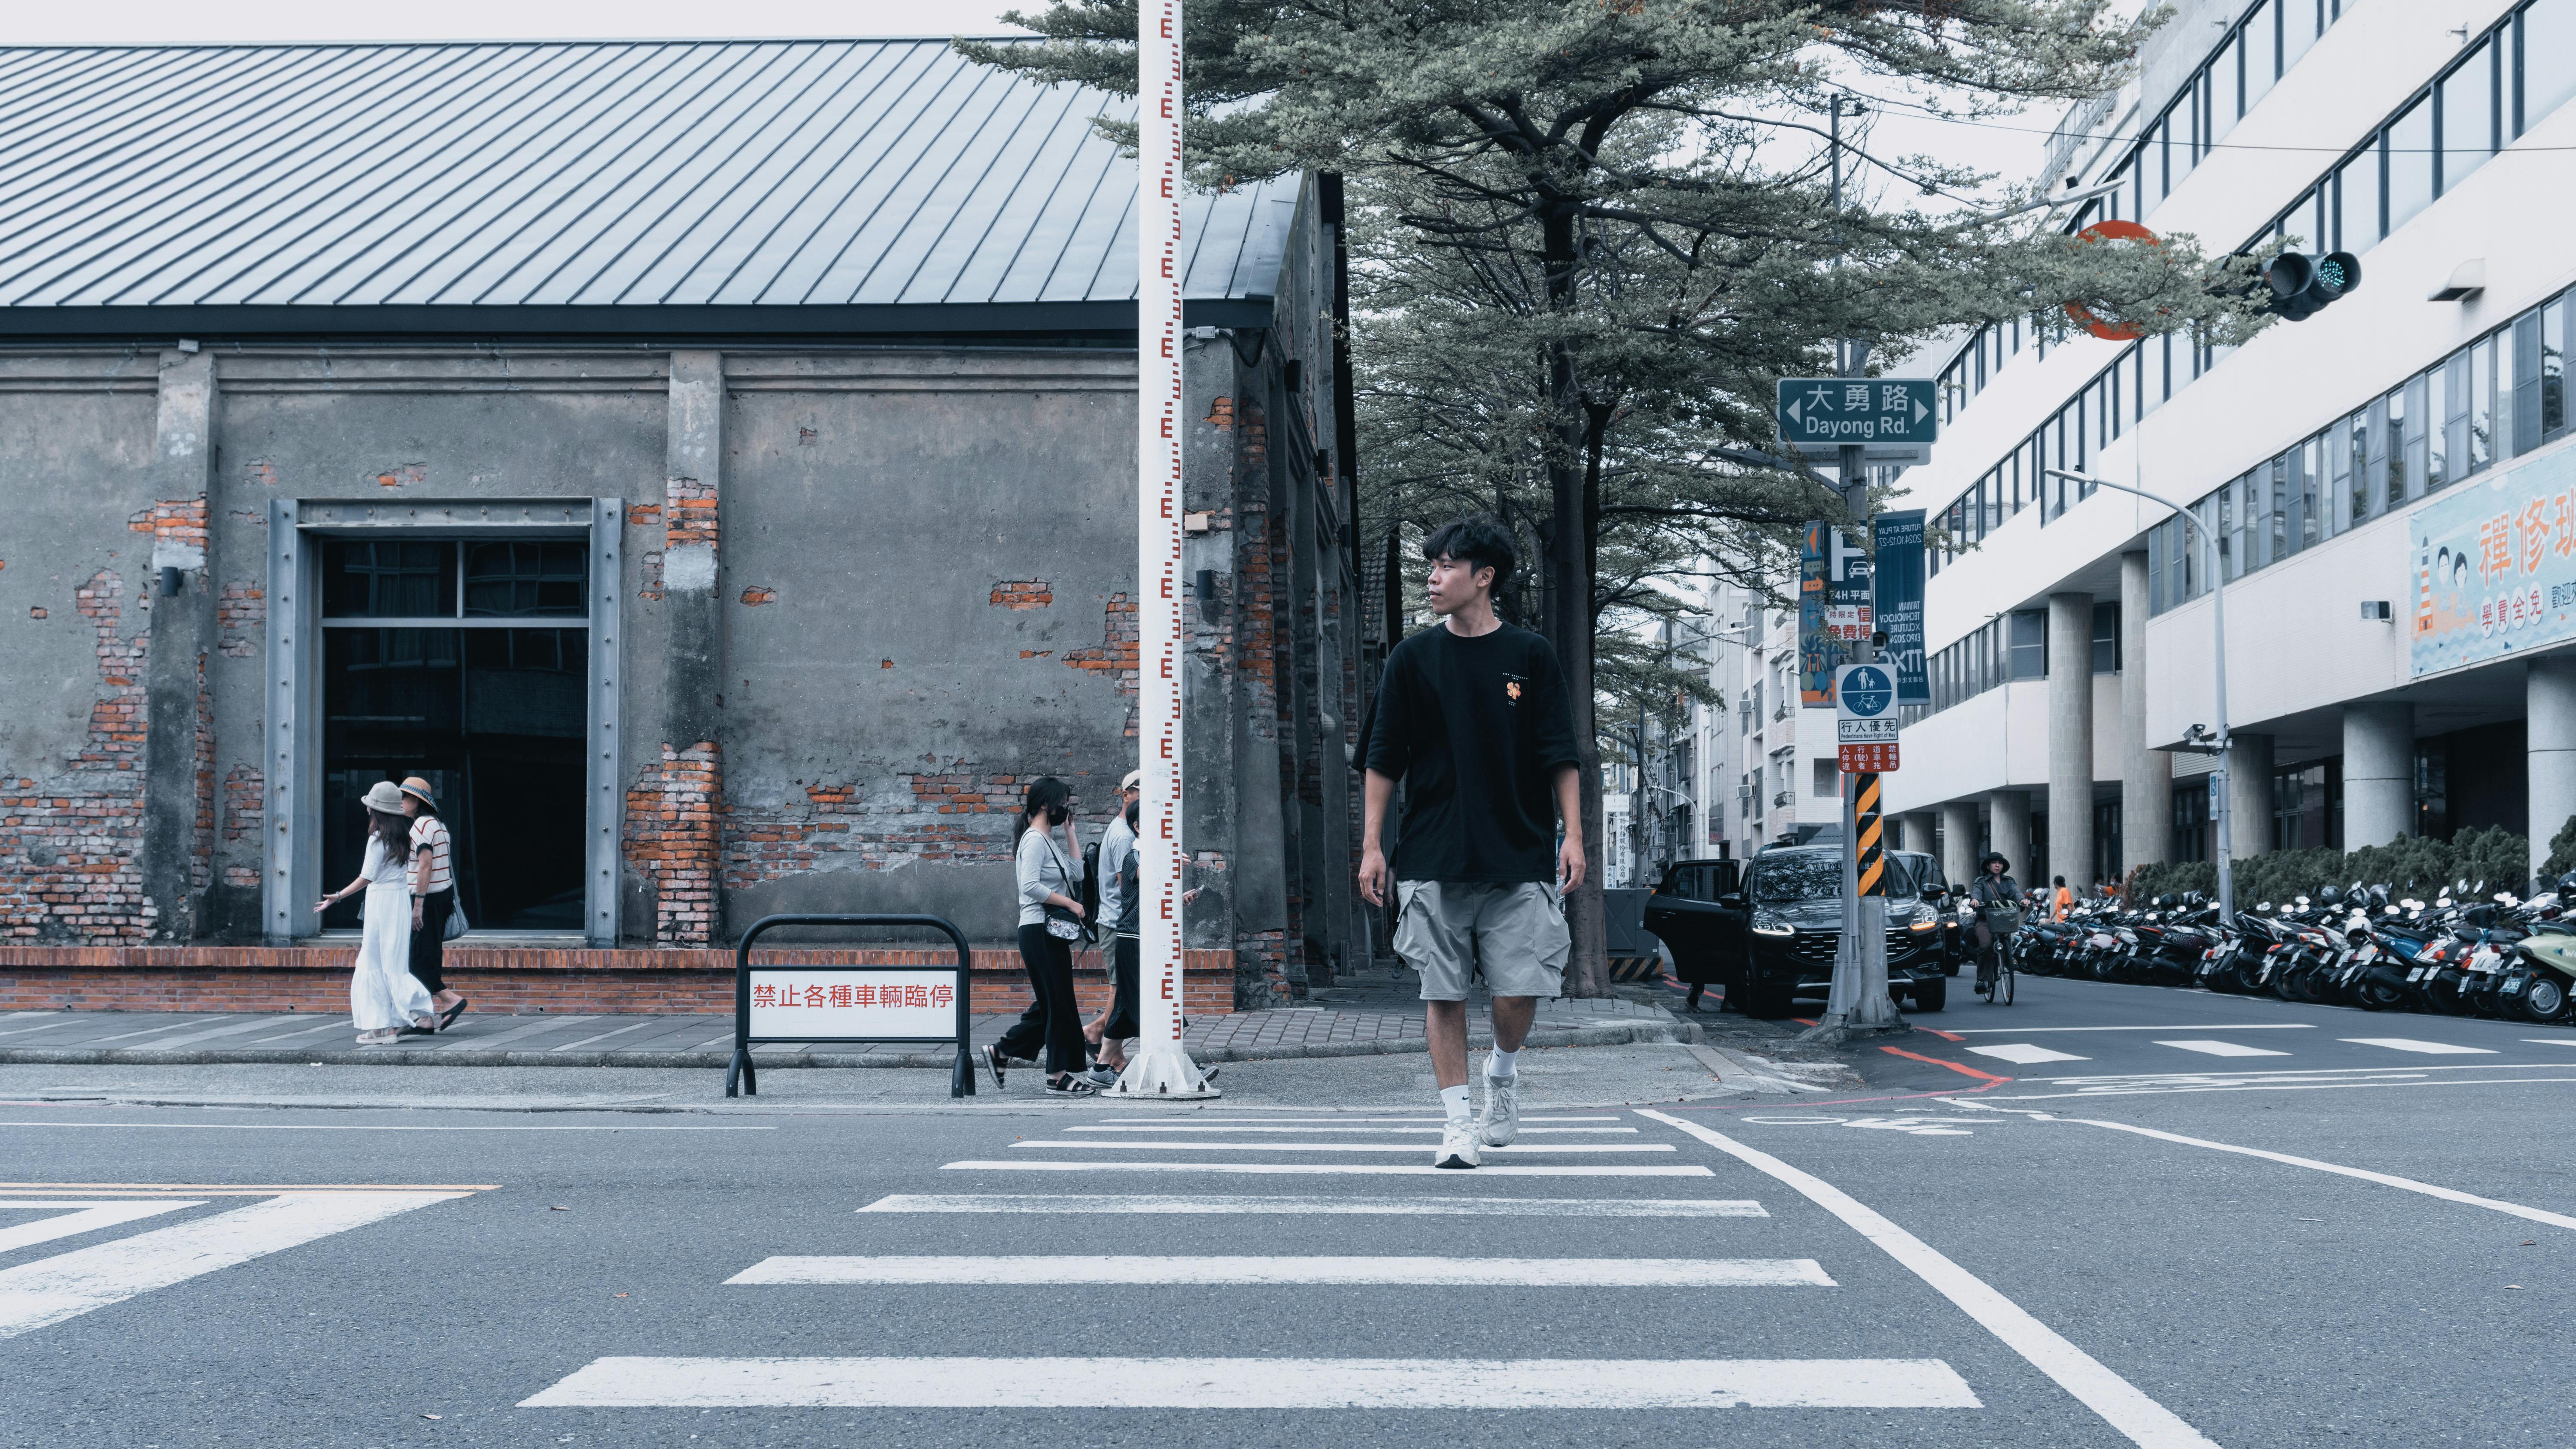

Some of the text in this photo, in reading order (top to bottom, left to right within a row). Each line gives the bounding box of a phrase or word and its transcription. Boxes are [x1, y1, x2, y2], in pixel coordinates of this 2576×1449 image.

[1807, 384, 1909, 412] 大勇路
[1806, 416, 1910, 438] Dayong Rd.
[1850, 590, 1870, 600] 平面
[2482, 590, 2542, 630] 學費全免
[1841, 720, 1896, 733] 行人優先
[753, 984, 954, 1008] 禁止各種車輛臨停
